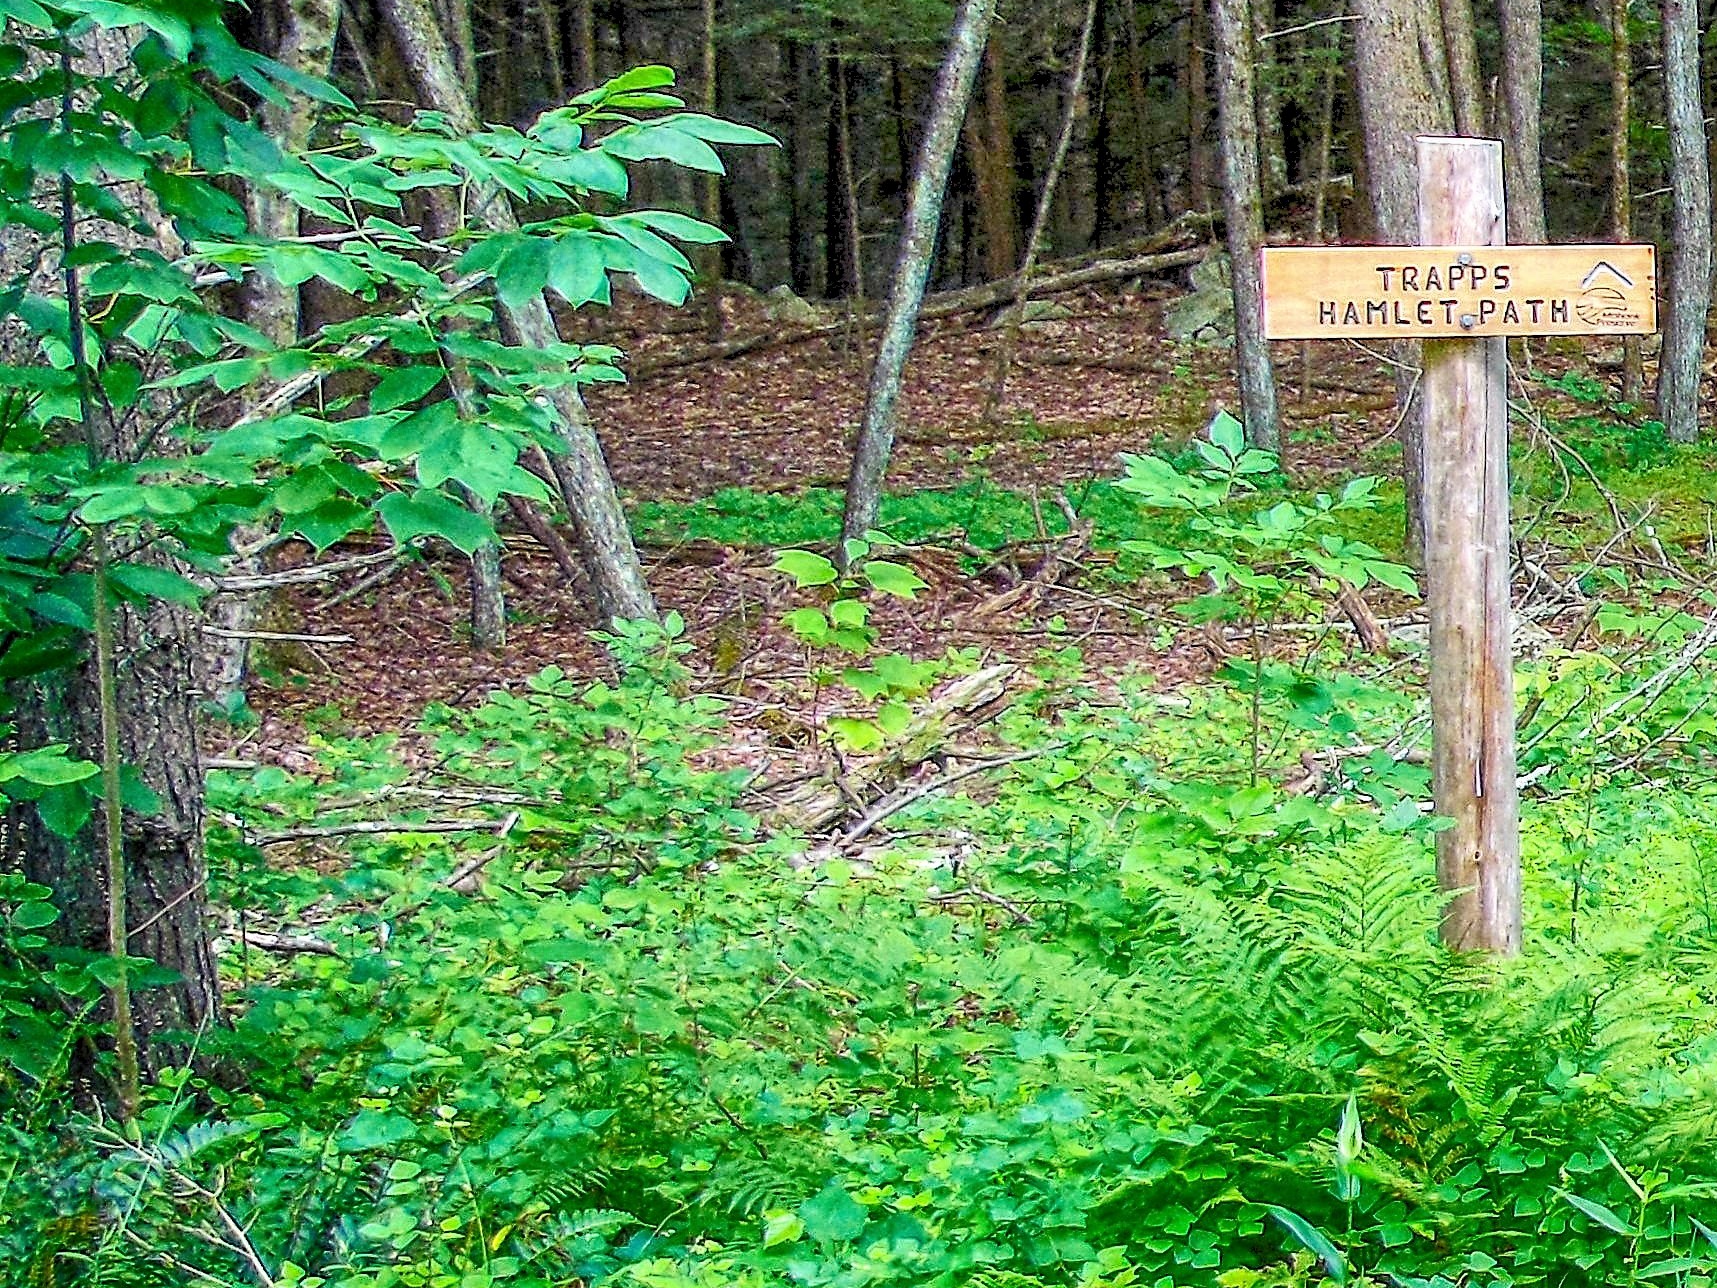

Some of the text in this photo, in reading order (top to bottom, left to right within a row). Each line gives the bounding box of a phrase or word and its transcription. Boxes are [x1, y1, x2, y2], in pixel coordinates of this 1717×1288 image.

[1375, 264, 1512, 292] TRAPPS
[1318, 298, 1570, 326] HAMLET PATH
